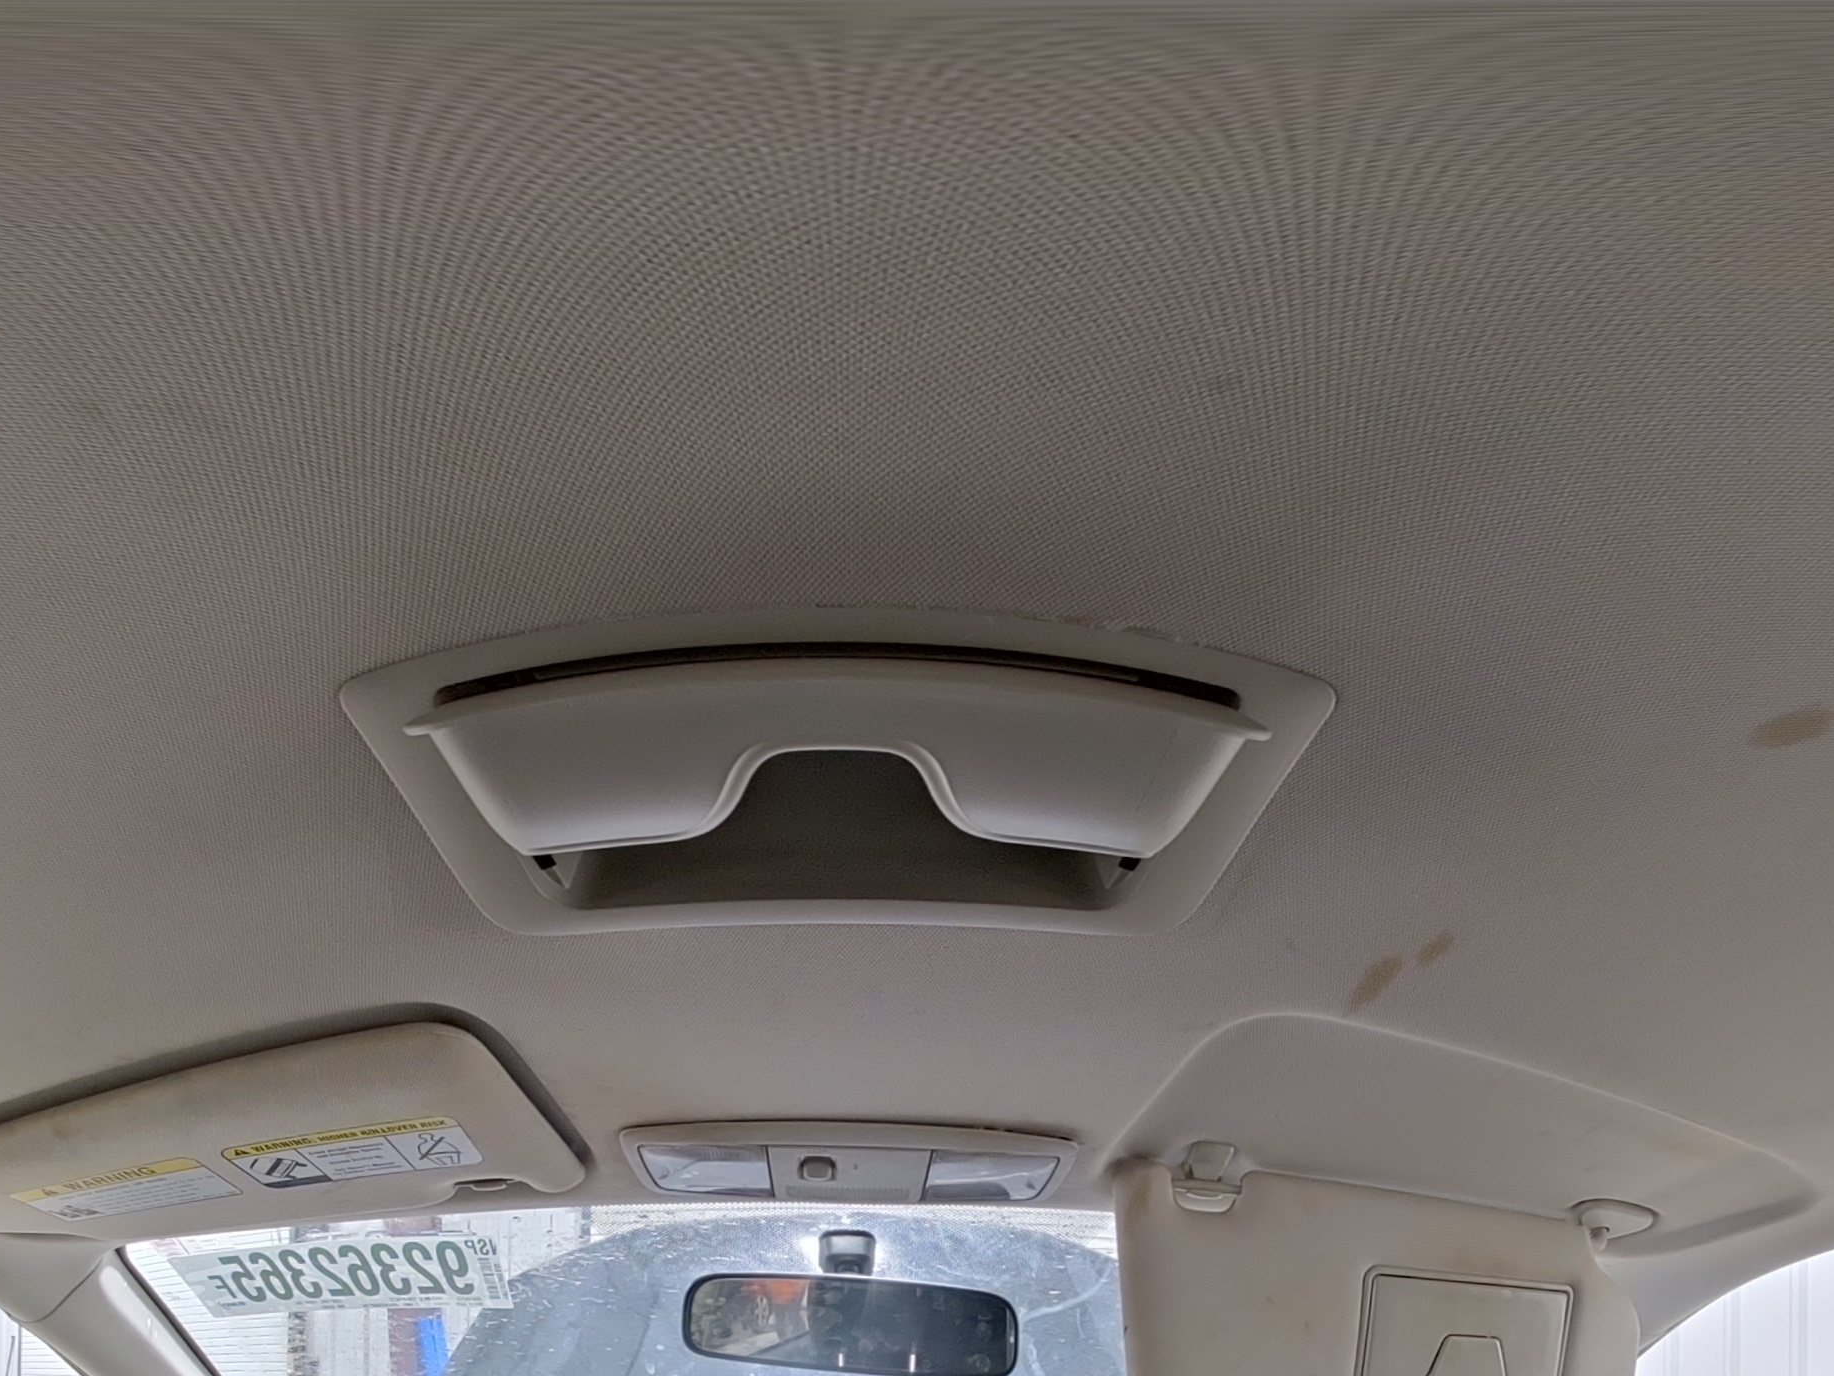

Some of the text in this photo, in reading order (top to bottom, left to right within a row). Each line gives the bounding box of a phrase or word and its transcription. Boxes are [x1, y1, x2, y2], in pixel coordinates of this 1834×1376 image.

[360, 1124, 418, 1136] ROLLOVER
[419, 1120, 447, 1129] RISK
[62, 1166, 157, 1190] WARNING
